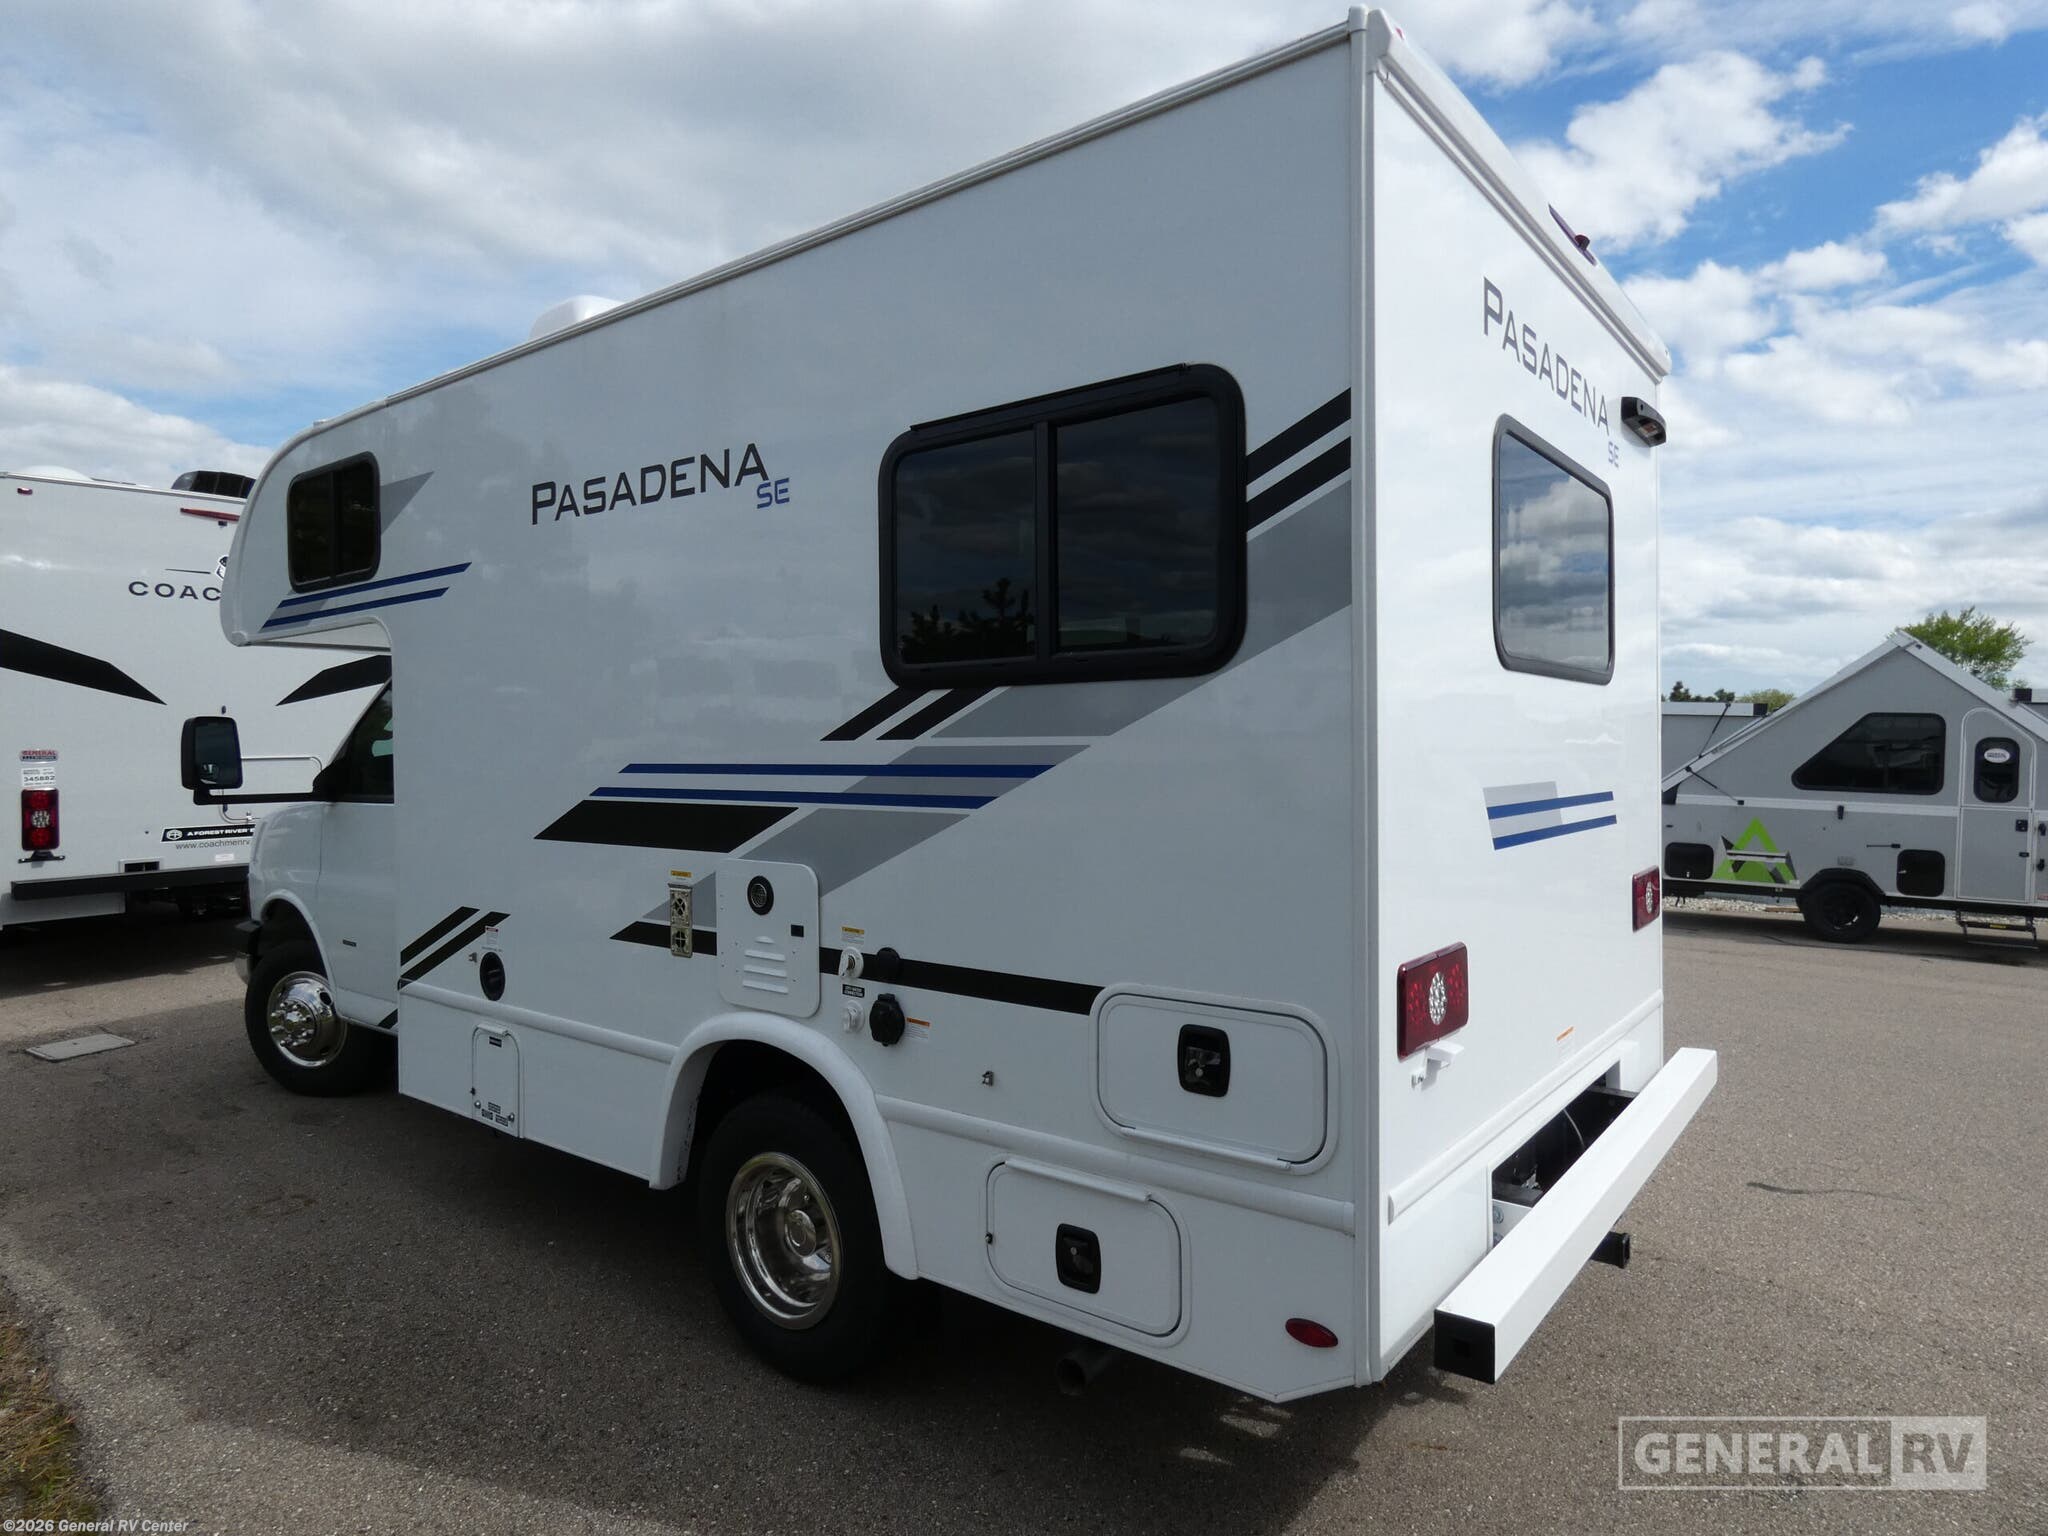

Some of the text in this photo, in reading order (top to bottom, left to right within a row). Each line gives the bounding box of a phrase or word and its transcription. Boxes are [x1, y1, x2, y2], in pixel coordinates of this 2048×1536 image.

[1484, 276, 1610, 436] PASADENA
[1608, 441, 1620, 469] SE
[532, 443, 769, 525] PASADENA
[756, 477, 790, 509] SE
